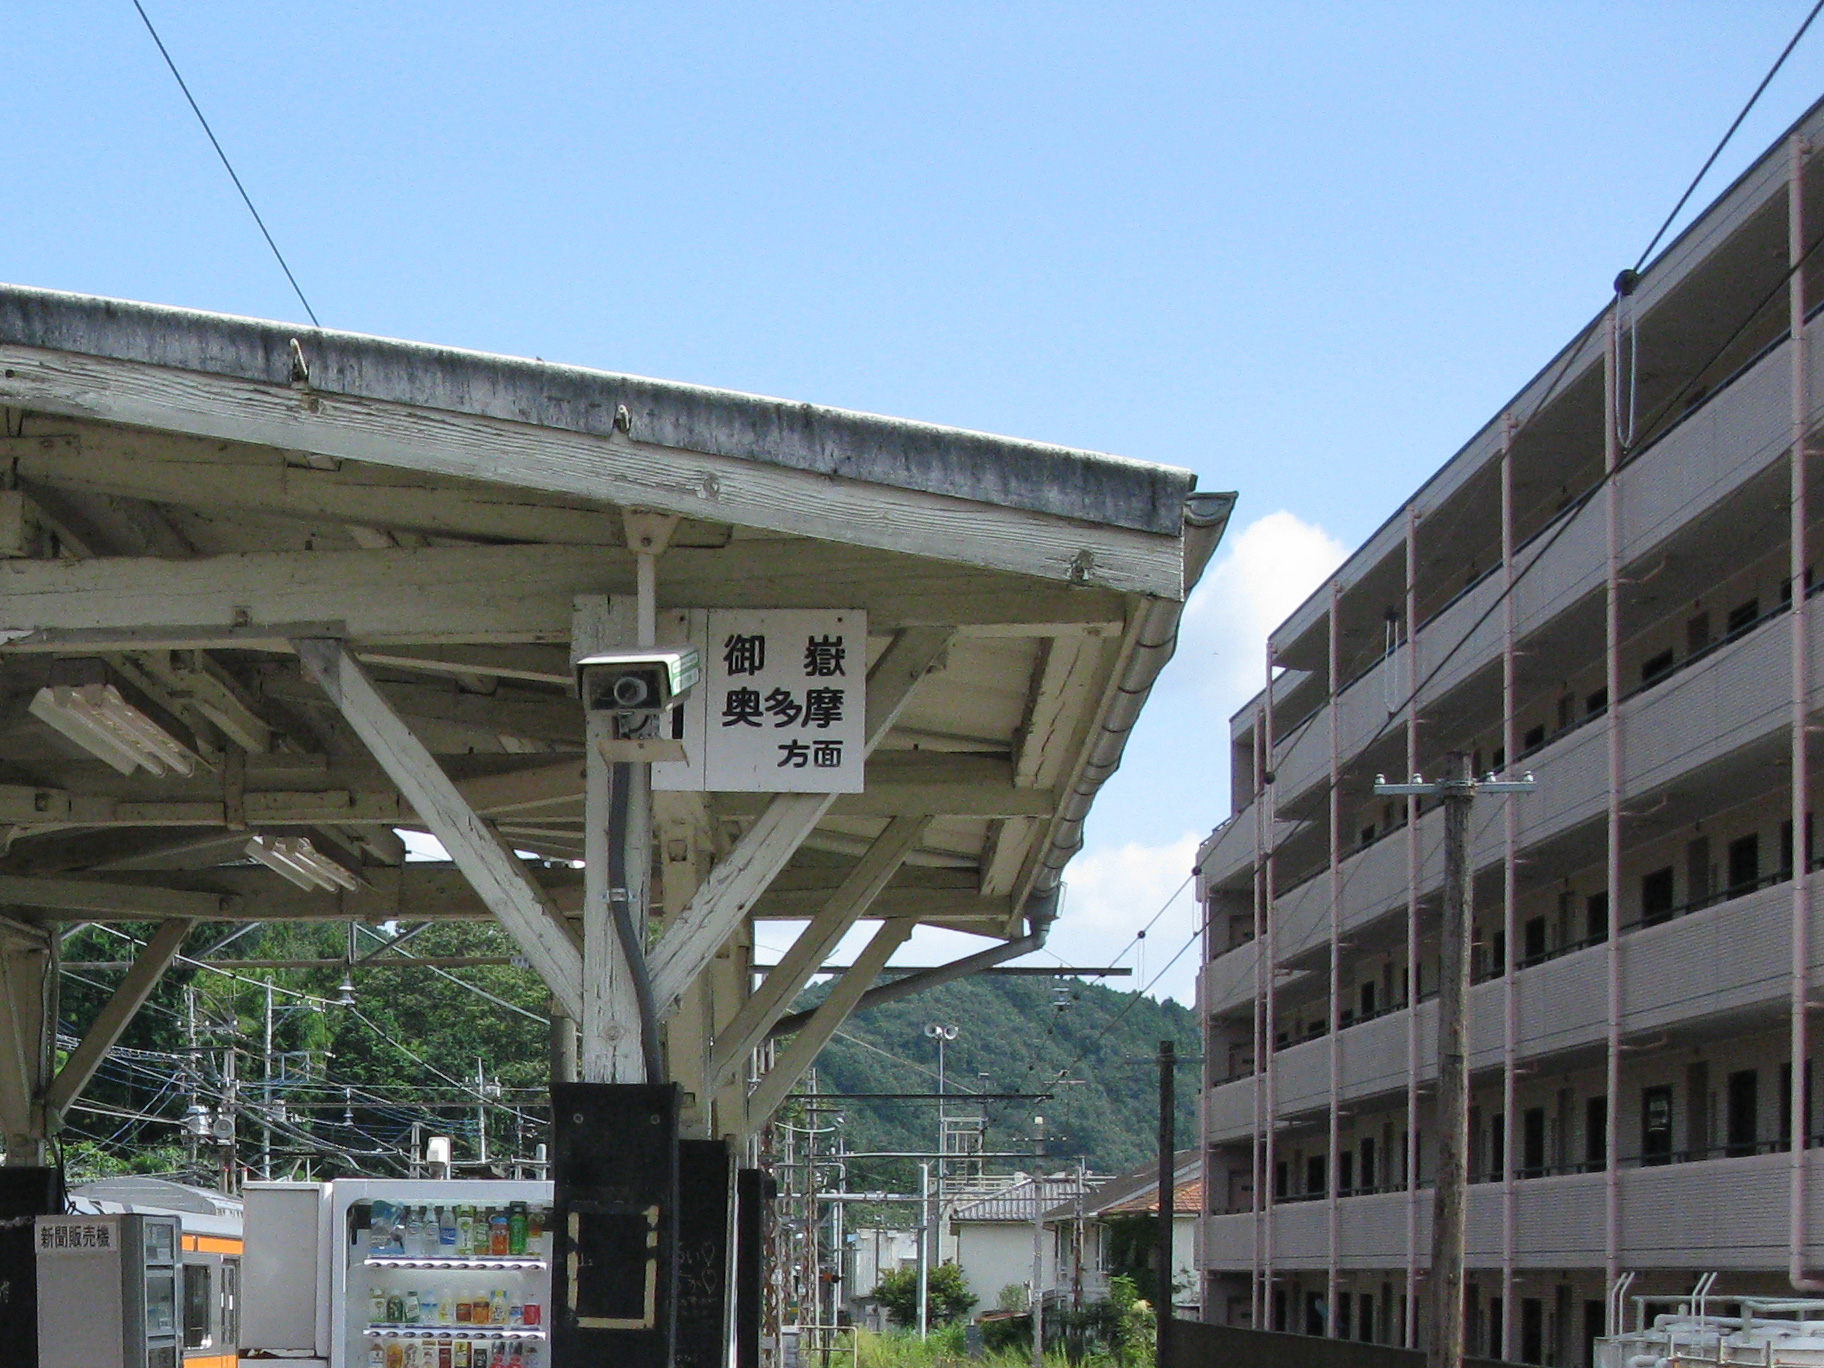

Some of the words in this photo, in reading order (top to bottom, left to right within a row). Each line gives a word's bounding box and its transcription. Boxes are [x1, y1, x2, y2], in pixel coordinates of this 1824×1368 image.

[722, 633, 846, 678] 御嶽
[721, 686, 845, 729] 奥多摩
[776, 738, 844, 769] 方面
[39, 1225, 112, 1250] 新聞販売機
